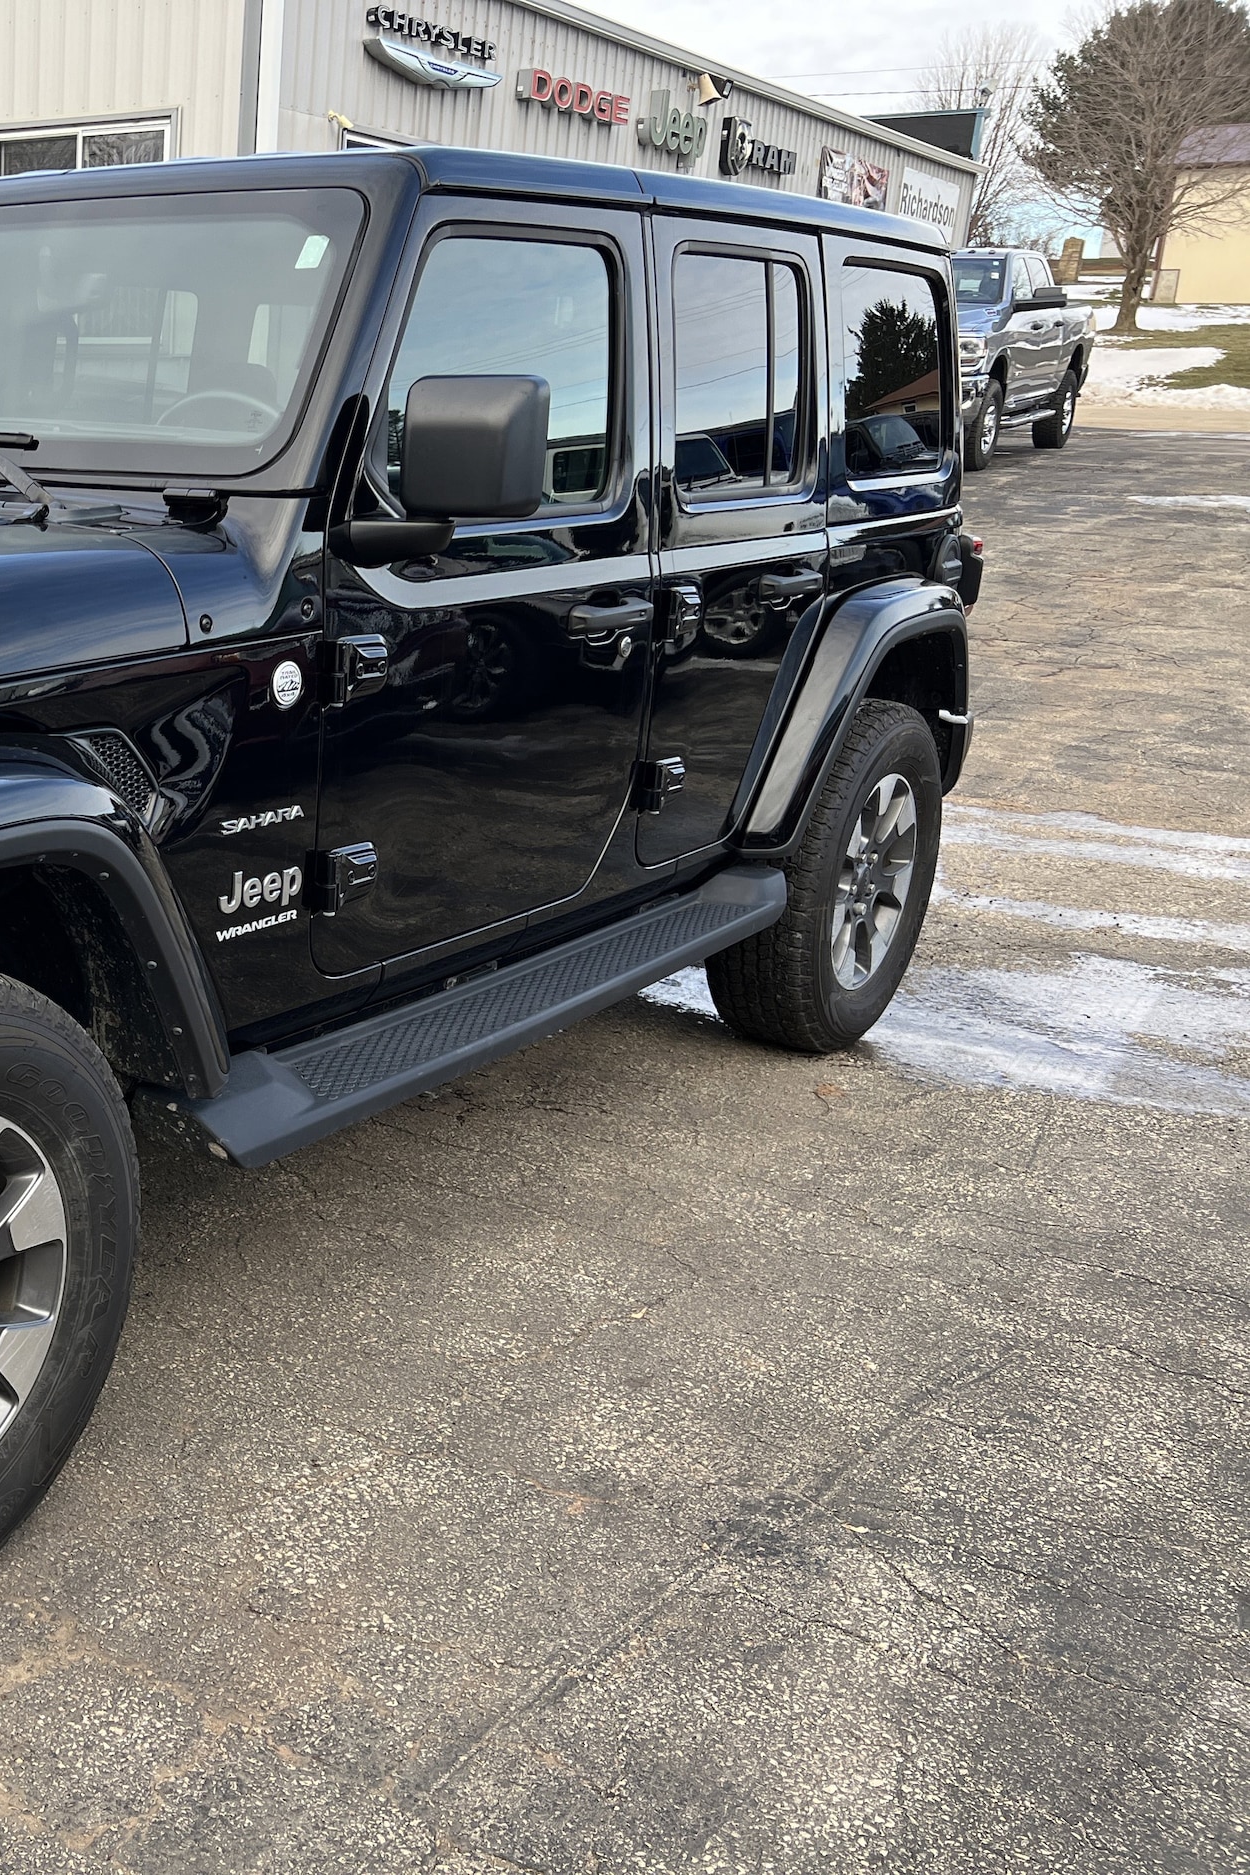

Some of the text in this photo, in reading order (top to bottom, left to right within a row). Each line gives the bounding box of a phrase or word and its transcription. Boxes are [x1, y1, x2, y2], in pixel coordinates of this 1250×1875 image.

[376, 4, 497, 61] CHRYSLER
[530, 69, 631, 125] DODGE
[649, 89, 707, 160] Jeep
[751, 138, 798, 175] RAM
[899, 182, 955, 228] Richardson
[219, 805, 305, 836] SAHARA
[218, 866, 303, 914] Jeep
[215, 909, 298, 942] WRANGLER
[5, 1062, 119, 1379] GOODYEAR
